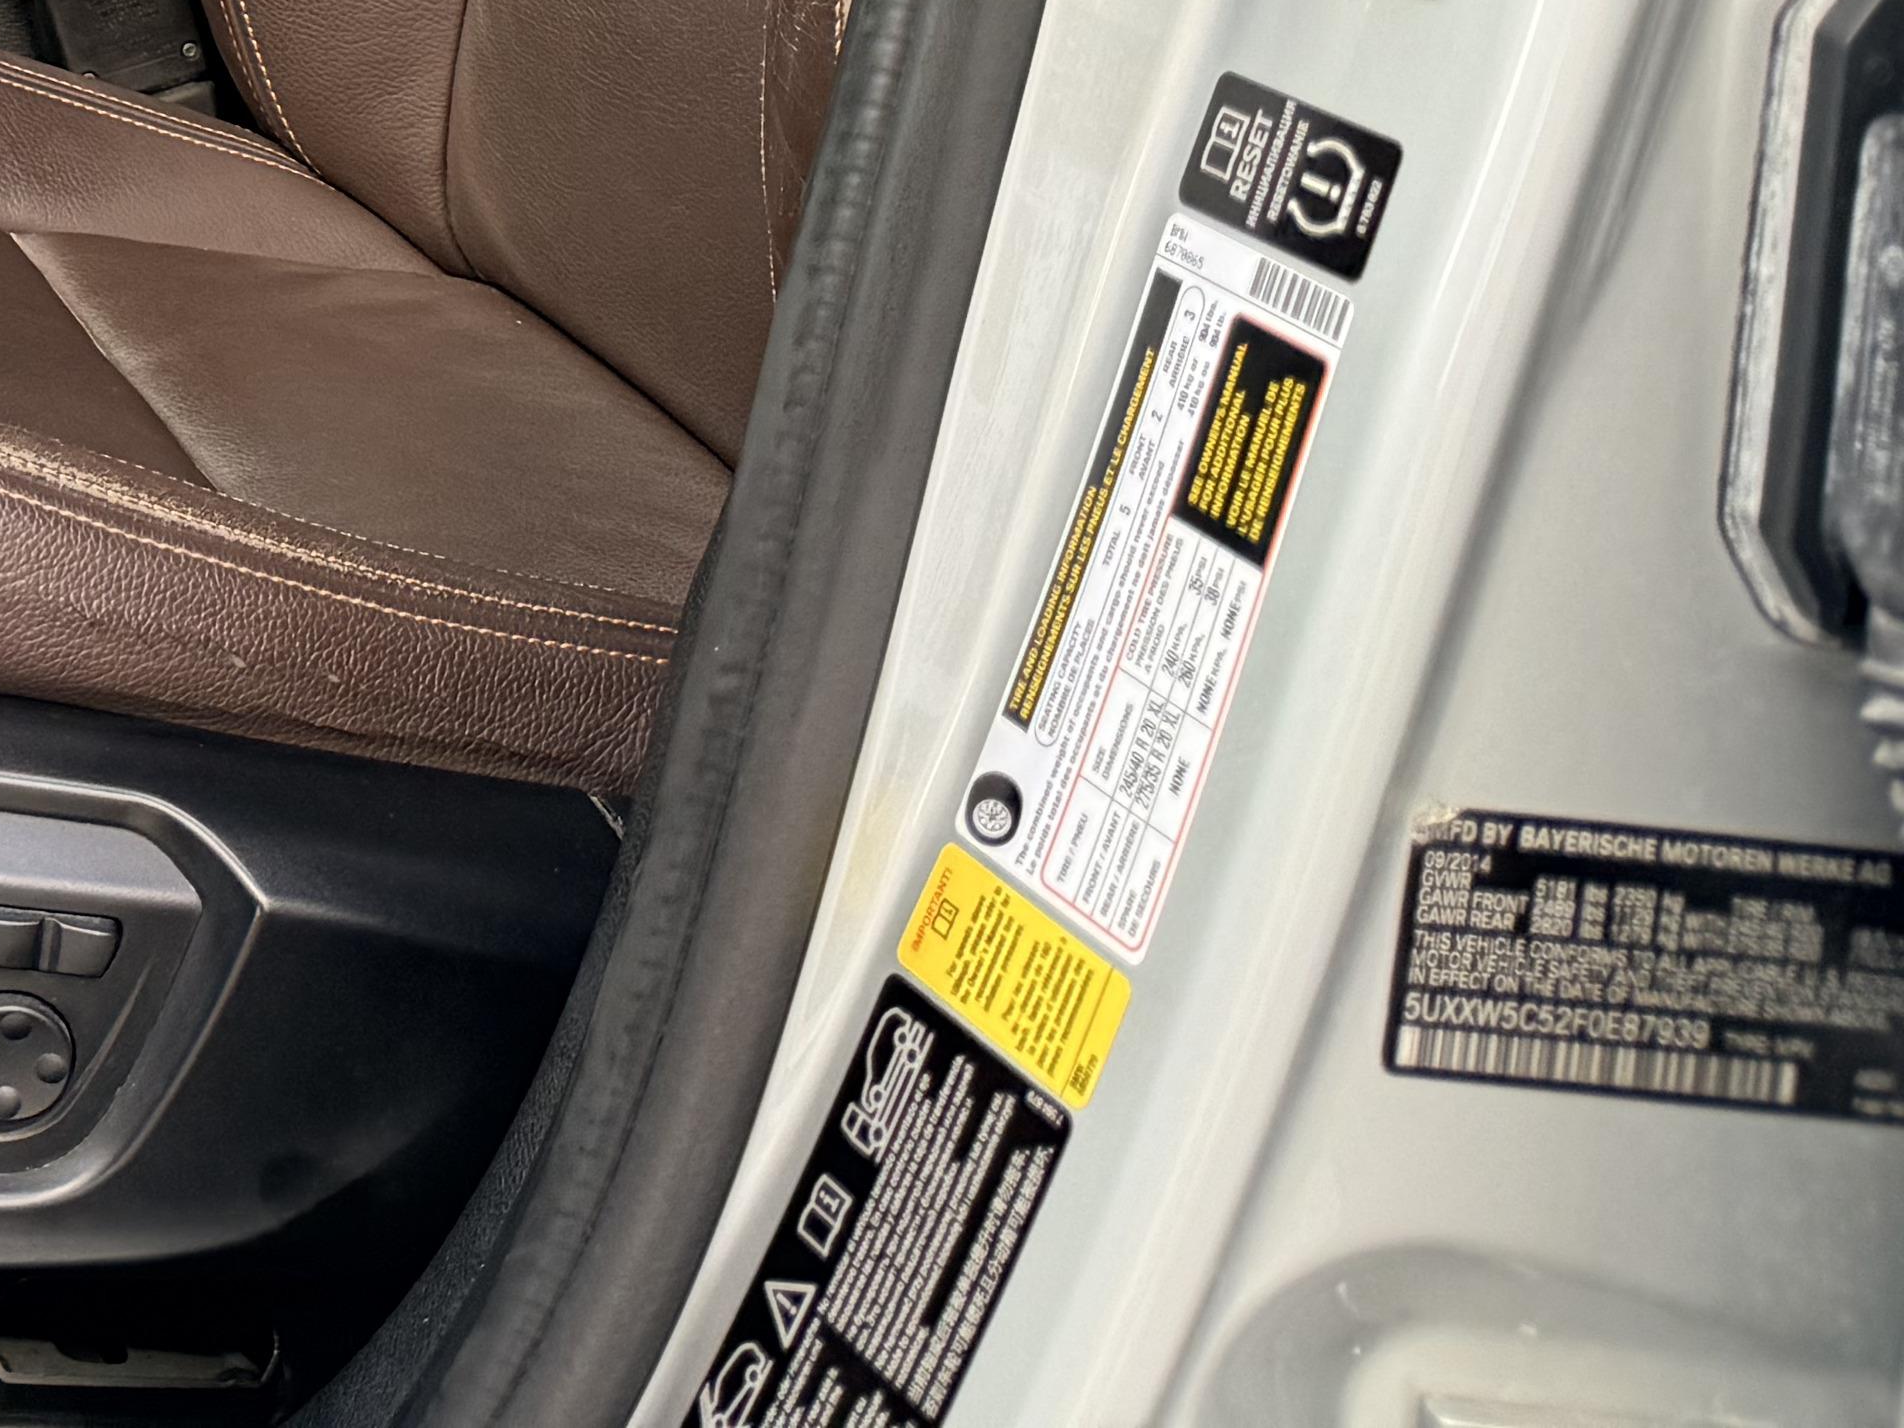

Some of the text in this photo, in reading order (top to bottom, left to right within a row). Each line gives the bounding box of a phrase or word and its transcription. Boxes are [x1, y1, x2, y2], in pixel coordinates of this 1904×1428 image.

[1228, 107, 1276, 202] RESET
[1244, 99, 1298, 228] ИНИЦИАЛИЗАЦИЯ
[1266, 119, 1310, 221] RESETOWANIE
[1184, 308, 1196, 321] 3
[1162, 340, 1178, 373] REAR
[1151, 409, 1163, 422] 2
[1187, 339, 1249, 506] SEE OWNER'S MANUAL
[1128, 433, 1147, 475] FRONT
[1137, 438, 1156, 481] AVANT
[1198, 387, 1246, 511] FOR ADDITIONAL
[1208, 413, 1252, 518] INFORMATION
[1224, 379, 1280, 528] VOIR LE MANUEL DE
[1235, 375, 1295, 534] L'USAGER POUR PLUS
[1247, 381, 1309, 542] DE RENSEIGNEMENTS
[1019, 346, 1157, 721] RENSEIGNEMENTS SUR LES PNEUS ET LE CHARGEMENT
[1102, 503, 1131, 568] TOTAL 5
[1146, 532, 1174, 597] PRESSURE
[1188, 574, 1205, 596] 35
[1008, 484, 1097, 713] TIRE AND LOADING INFORMATION
[1133, 537, 1184, 668] PRESSION DES PNEUS
[1204, 584, 1221, 606] 38
[1220, 598, 1241, 640] NONE
[1146, 622, 1165, 662] FROID
[1160, 647, 1180, 678] 240
[1024, 777, 1054, 843] combined
[1047, 733, 1071, 780] weight
[1071, 652, 1101, 719] occupants
[1132, 506, 1150, 543] never
[1037, 620, 1082, 732] SEATING CAPACITY
[1176, 658, 1197, 689] 260
[1195, 673, 1217, 714] NONE
[1047, 683, 1071, 739] NOMBRE
[1140, 716, 1157, 737] 20
[1146, 695, 1164, 719] XL
[1163, 706, 1180, 729] XL
[1091, 744, 1106, 774] SIZE
[1101, 701, 1134, 781] DIMENSIONS
[1155, 726, 1173, 749] 20
[1119, 749, 1145, 799] 245/40
[1134, 760, 1162, 811] 275/35
[1168, 755, 1189, 796] NONE
[1056, 811, 1089, 885] TIRE PNEU
[1082, 810, 1121, 905] FRONT AVANT
[1423, 850, 1491, 873] 09/2014
[1481, 822, 1513, 846] BY
[1519, 825, 1657, 861] BAYERISCHE
[1661, 839, 1772, 872] MOTOREN
[1100, 881, 1118, 918] REAR
[1127, 858, 1161, 939] DE SECOURS
[1418, 887, 1529, 914] GAWR FRONT
[1421, 869, 1472, 889] GVWR
[1535, 877, 1576, 900] 5181
[909, 866, 954, 951] IMPORTANT!
[1117, 887, 1137, 931] SPARE
[1415, 905, 1515, 931] GAWR REAR
[1529, 916, 1572, 937] 2820
[1411, 948, 1471, 970] MOTOR
[1476, 954, 1545, 977] VEHICLE
[1548, 961, 1607, 983] SAFETY
[1413, 929, 1627, 968] THIS VEHICLE CONFORMS
[1408, 967, 1628, 1004] IN EFFECT ON THE DATE OF
[1404, 990, 1710, 1050] 5UXXW5C52F0E87939
[889, 1099, 920, 1153] levantado
[876, 1185, 894, 1212] caso
[887, 1138, 915, 1187] contrario
[908, 1097, 934, 1140] pueden
